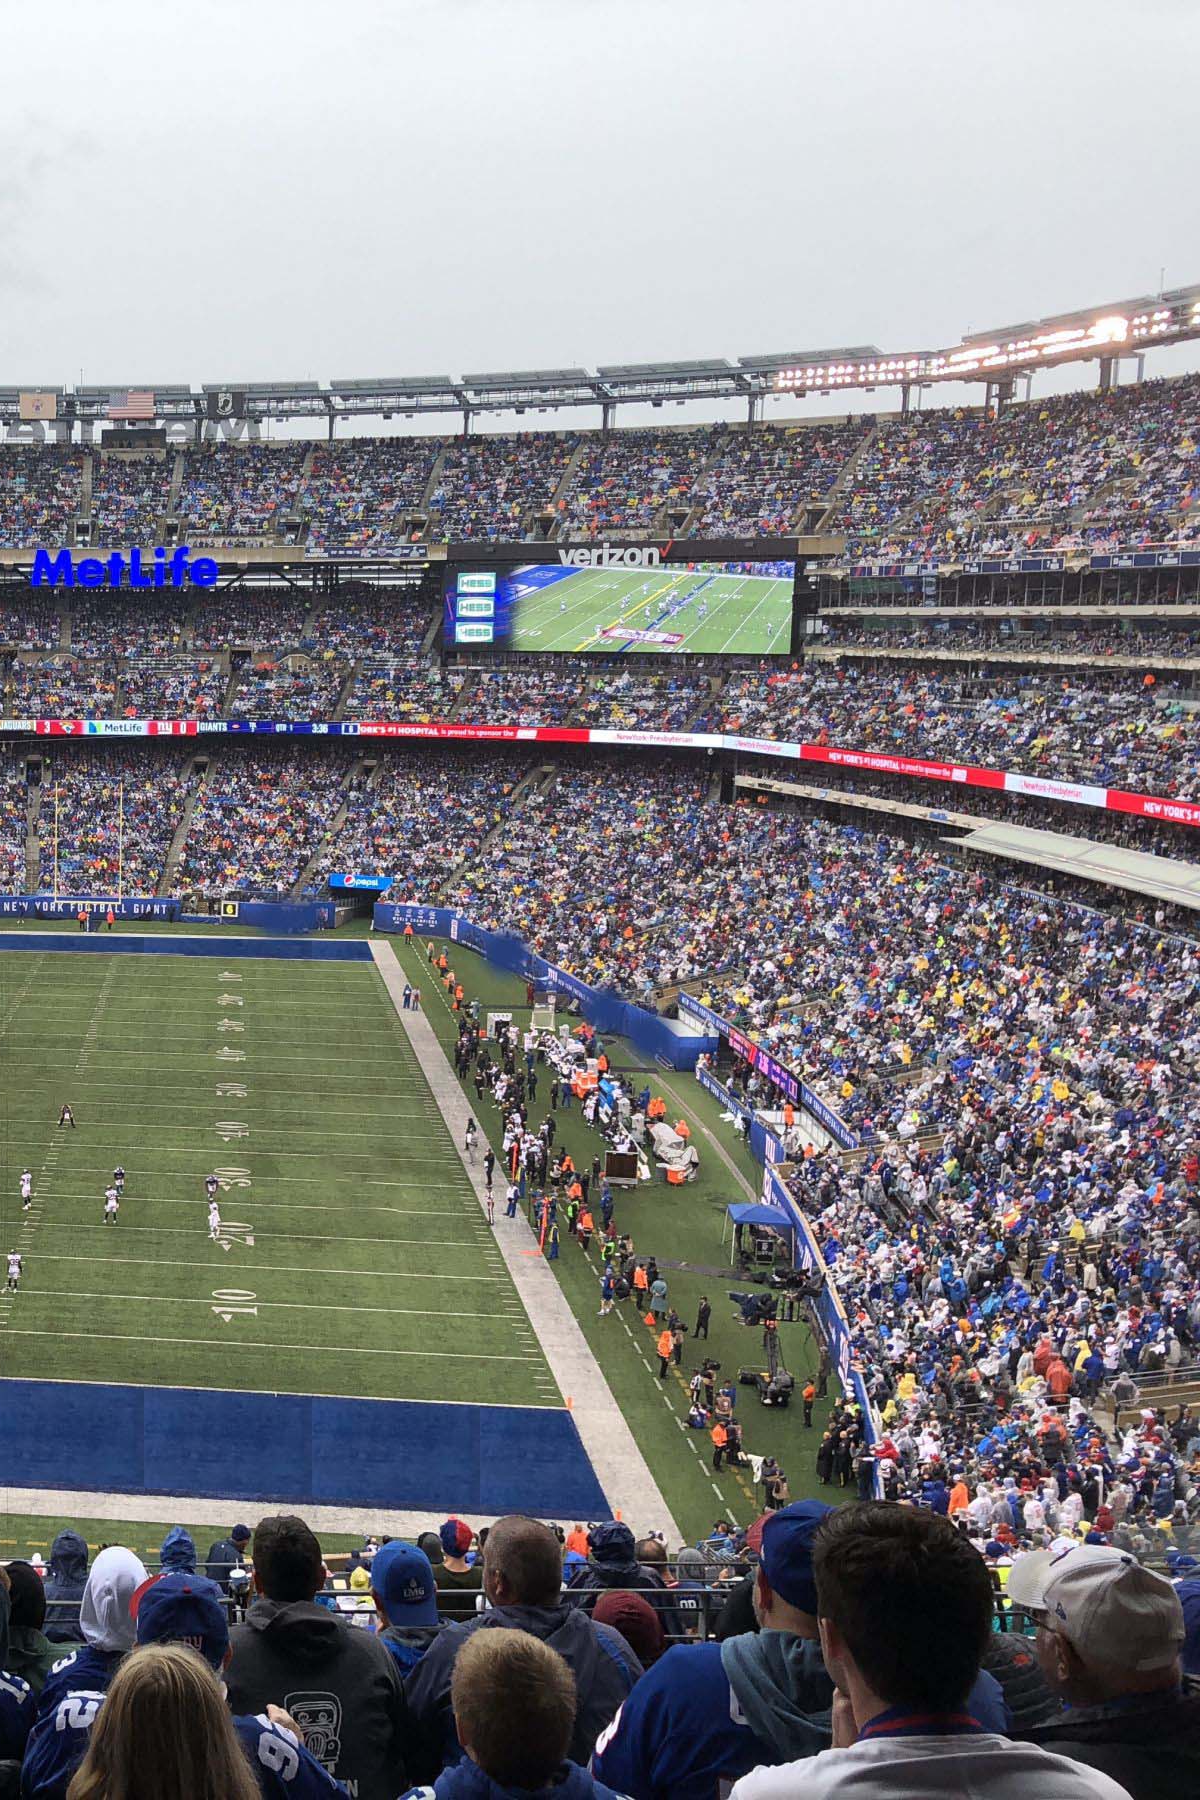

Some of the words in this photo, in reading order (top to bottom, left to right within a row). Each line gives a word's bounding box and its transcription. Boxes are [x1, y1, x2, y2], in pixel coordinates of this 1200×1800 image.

[559, 543, 660, 566] verizon
[31, 546, 219, 587] MetLife
[461, 578, 492, 587] HESS
[461, 602, 491, 611] HESS
[0, 721, 31, 730] JAGUARS
[44, 721, 50, 733] 3
[104, 723, 142, 732] MetLife
[180, 723, 187, 734] 0
[200, 722, 227, 731] GIANTS
[312, 723, 328, 733] 3:36
[398, 727, 439, 736] HOSPITAL
[447, 728, 467, 737] proud
[476, 730, 502, 738] sponsor
[829, 752, 842, 760] NEW
[871, 759, 899, 769] HOSPITAL
[1144, 802, 1161, 814] NEW
[1163, 806, 1192, 820] YORK'S
[356, 878, 378, 887] pepsi
[3, 901, 28, 912] NEW
[35, 901, 64, 913] YORK
[70, 902, 127, 914] FOOTBALL
[213, 1221, 255, 1246] 20
[211, 1288, 257, 1316] 10
